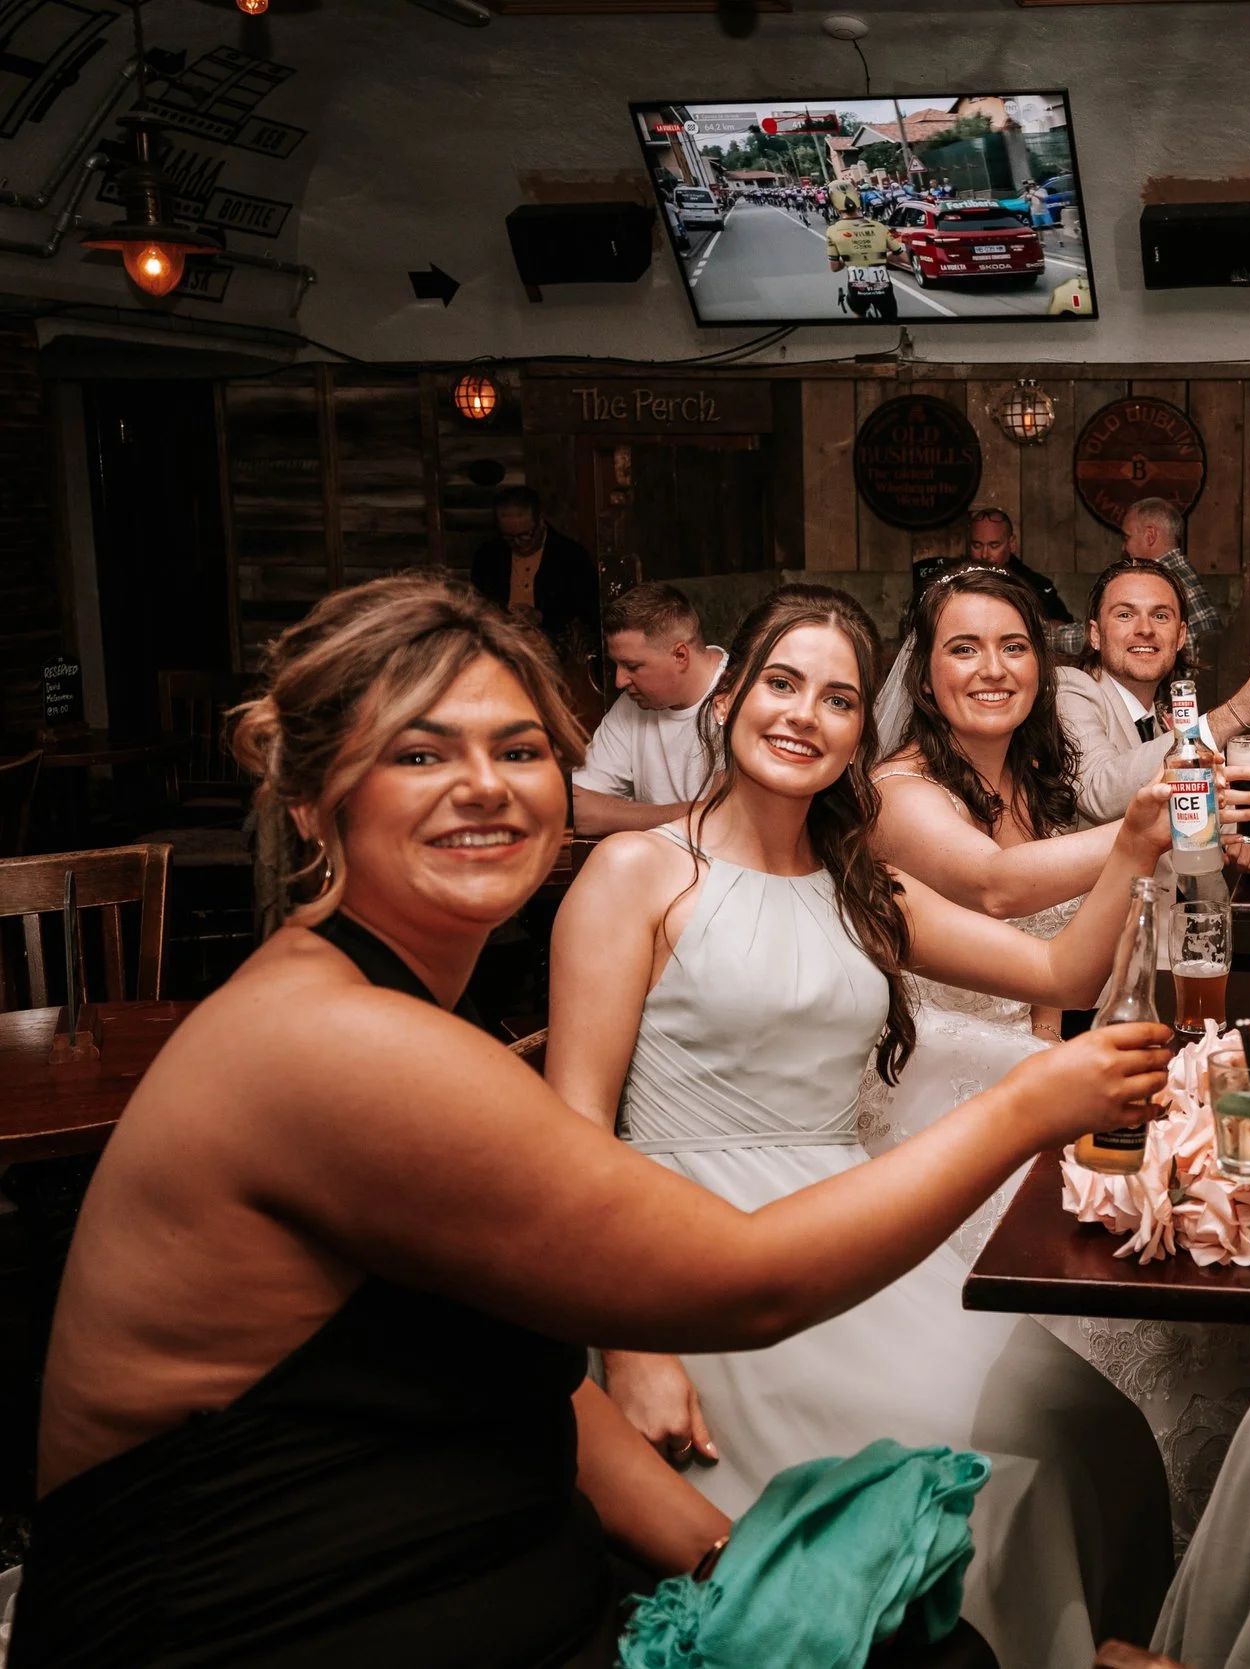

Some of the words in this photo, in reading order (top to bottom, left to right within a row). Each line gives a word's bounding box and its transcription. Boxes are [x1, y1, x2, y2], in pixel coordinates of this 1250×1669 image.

[704, 123, 721, 131] 64.2
[722, 122, 735, 130] km
[251, 123, 285, 150] KEG
[945, 199, 999, 210] Fertiberia
[217, 197, 276, 229] BOTTLE
[853, 269, 865, 282] 12
[873, 269, 886, 283] 12
[572, 387, 629, 423] The
[634, 389, 721, 424] Perch
[892, 424, 941, 444] OLD
[1085, 413, 1122, 455] OLD
[1123, 405, 1197, 456] DUBLIN
[860, 443, 976, 465] BUSHMILLS
[1132, 459, 1147, 481] B
[44, 663, 79, 679] RESERVED
[1174, 708, 1190, 718] ICE
[1171, 782, 1206, 793] MIRNOFF
[1173, 796, 1201, 811] ICE
[1176, 812, 1199, 821] ORIGINAL
